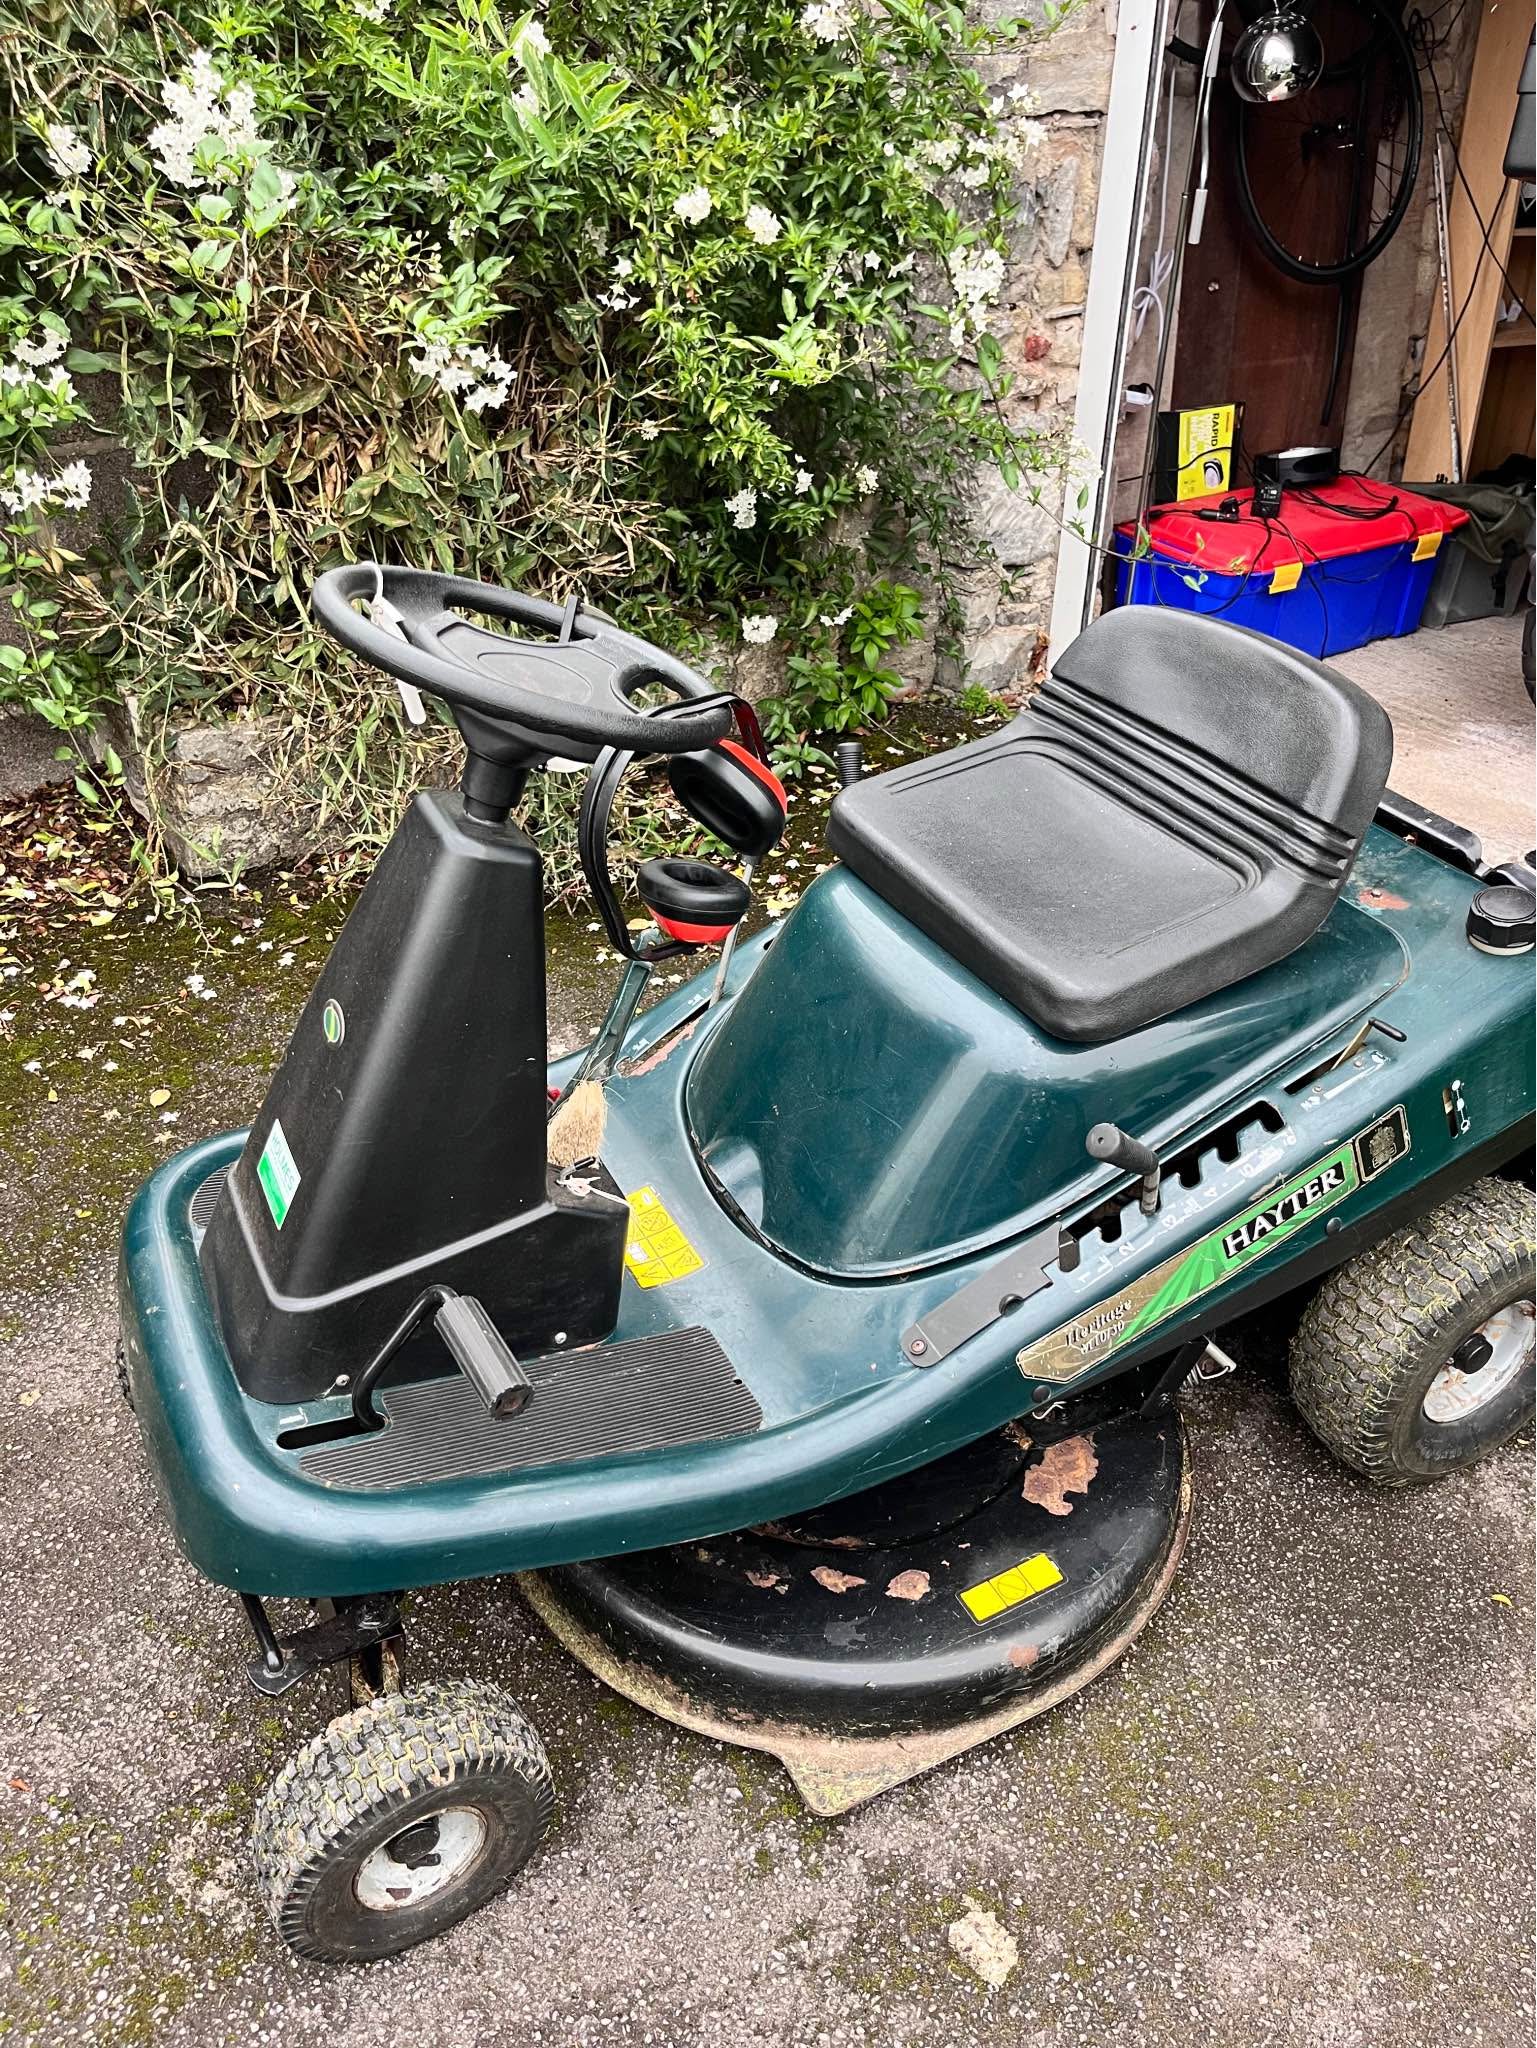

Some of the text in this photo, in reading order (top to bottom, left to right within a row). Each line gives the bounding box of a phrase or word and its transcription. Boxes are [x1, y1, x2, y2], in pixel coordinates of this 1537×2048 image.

[1211, 413, 1220, 447] RAPID
[1224, 1168, 1342, 1257] HAYTER
[1065, 1299, 1132, 1346] Heritage
